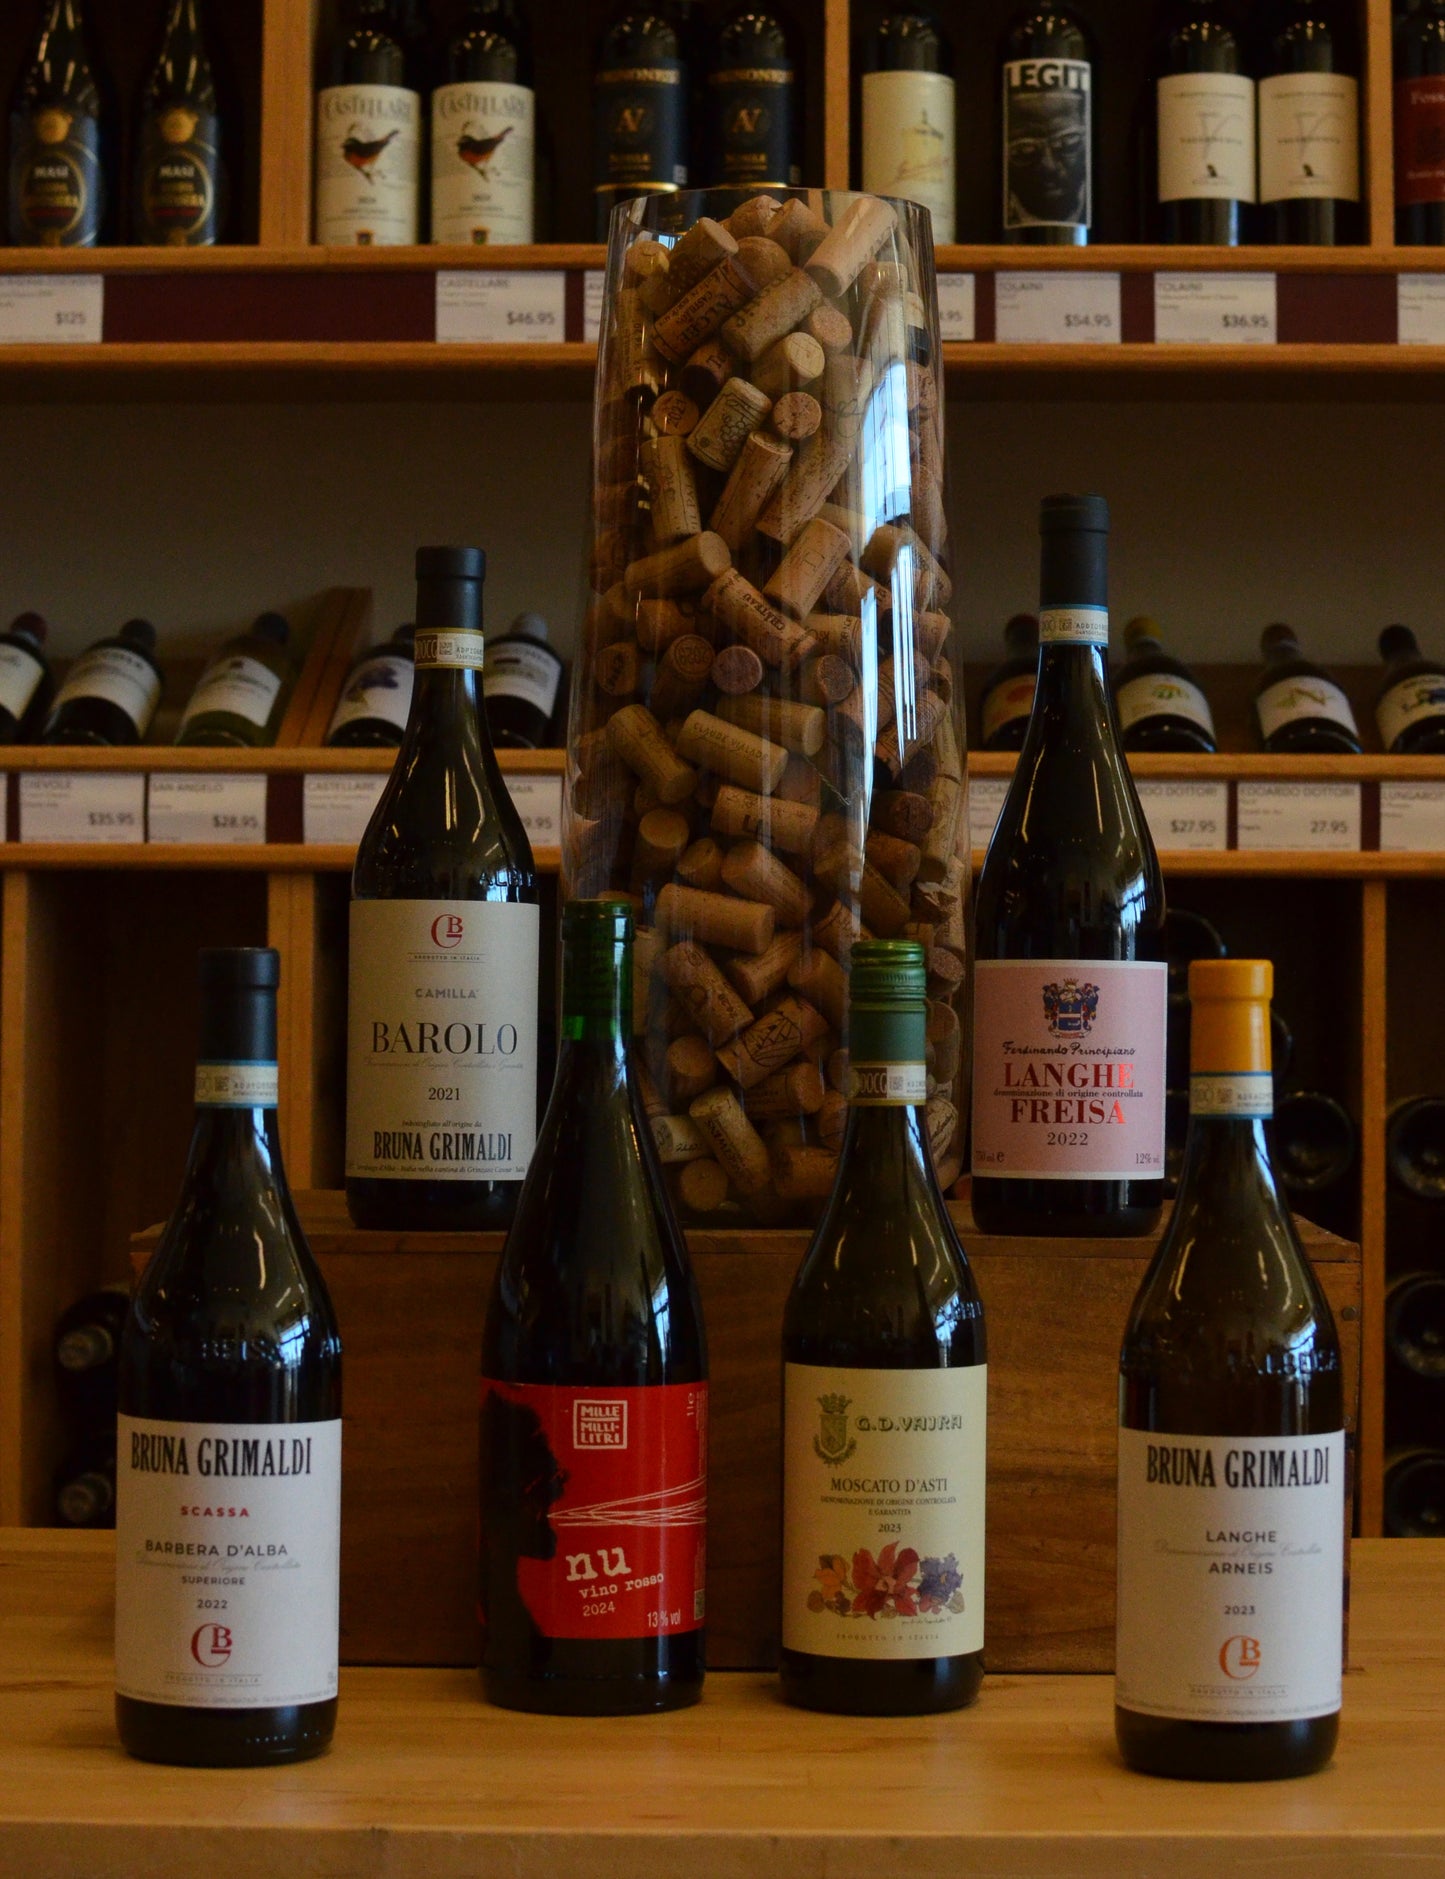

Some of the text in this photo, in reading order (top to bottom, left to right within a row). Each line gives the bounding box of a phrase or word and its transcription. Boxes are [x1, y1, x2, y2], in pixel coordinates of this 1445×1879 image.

[1007, 62, 1087, 88] LEGIT
[507, 311, 555, 326] $46.95
[1065, 313, 1112, 328] $54.95
[1222, 314, 1269, 329] $36.95
[88, 812, 134, 826] $35.95
[213, 814, 258, 829] $28.95
[1171, 820, 1216, 833] $27.95
[1310, 820, 1348, 834] 27.95
[415, 988, 477, 999] CAMILLA
[371, 1022, 518, 1055] BAROLO
[1002, 1040, 1136, 1058] Ferdinando Principiano
[1004, 1063, 1134, 1088] LANGHE
[428, 1087, 461, 1101] 2021
[994, 1088, 1144, 1098] denominazione di origine controllata
[1011, 1099, 1126, 1124] FREISA
[373, 1131, 512, 1161] BRUNA GRIMALDI
[1047, 1132, 1089, 1146] 2022
[580, 1405, 620, 1418] MILLE
[580, 1422, 620, 1432] MILLI-
[580, 1432, 620, 1444] LITRI
[131, 1431, 311, 1477] BRUNA GRIMALDI
[1147, 1445, 1330, 1489] BRUNA GRIMALDI
[831, 1477, 948, 1493] MOSCATO D'ASTI
[180, 1506, 250, 1517] SCASSA
[1206, 1530, 1277, 1543] LANGHE
[145, 1539, 288, 1557] BARBERA D'ALBA
[565, 1546, 632, 1582] nu
[1208, 1562, 1273, 1574] ARNEIS
[182, 1575, 245, 1585] SUPERIORE
[579, 1572, 664, 1599] vino rosso
[197, 1599, 228, 1609] 2022
[582, 1601, 616, 1617] 2024
[1223, 1605, 1256, 1616] 2023
[670, 1608, 681, 1626] vol
